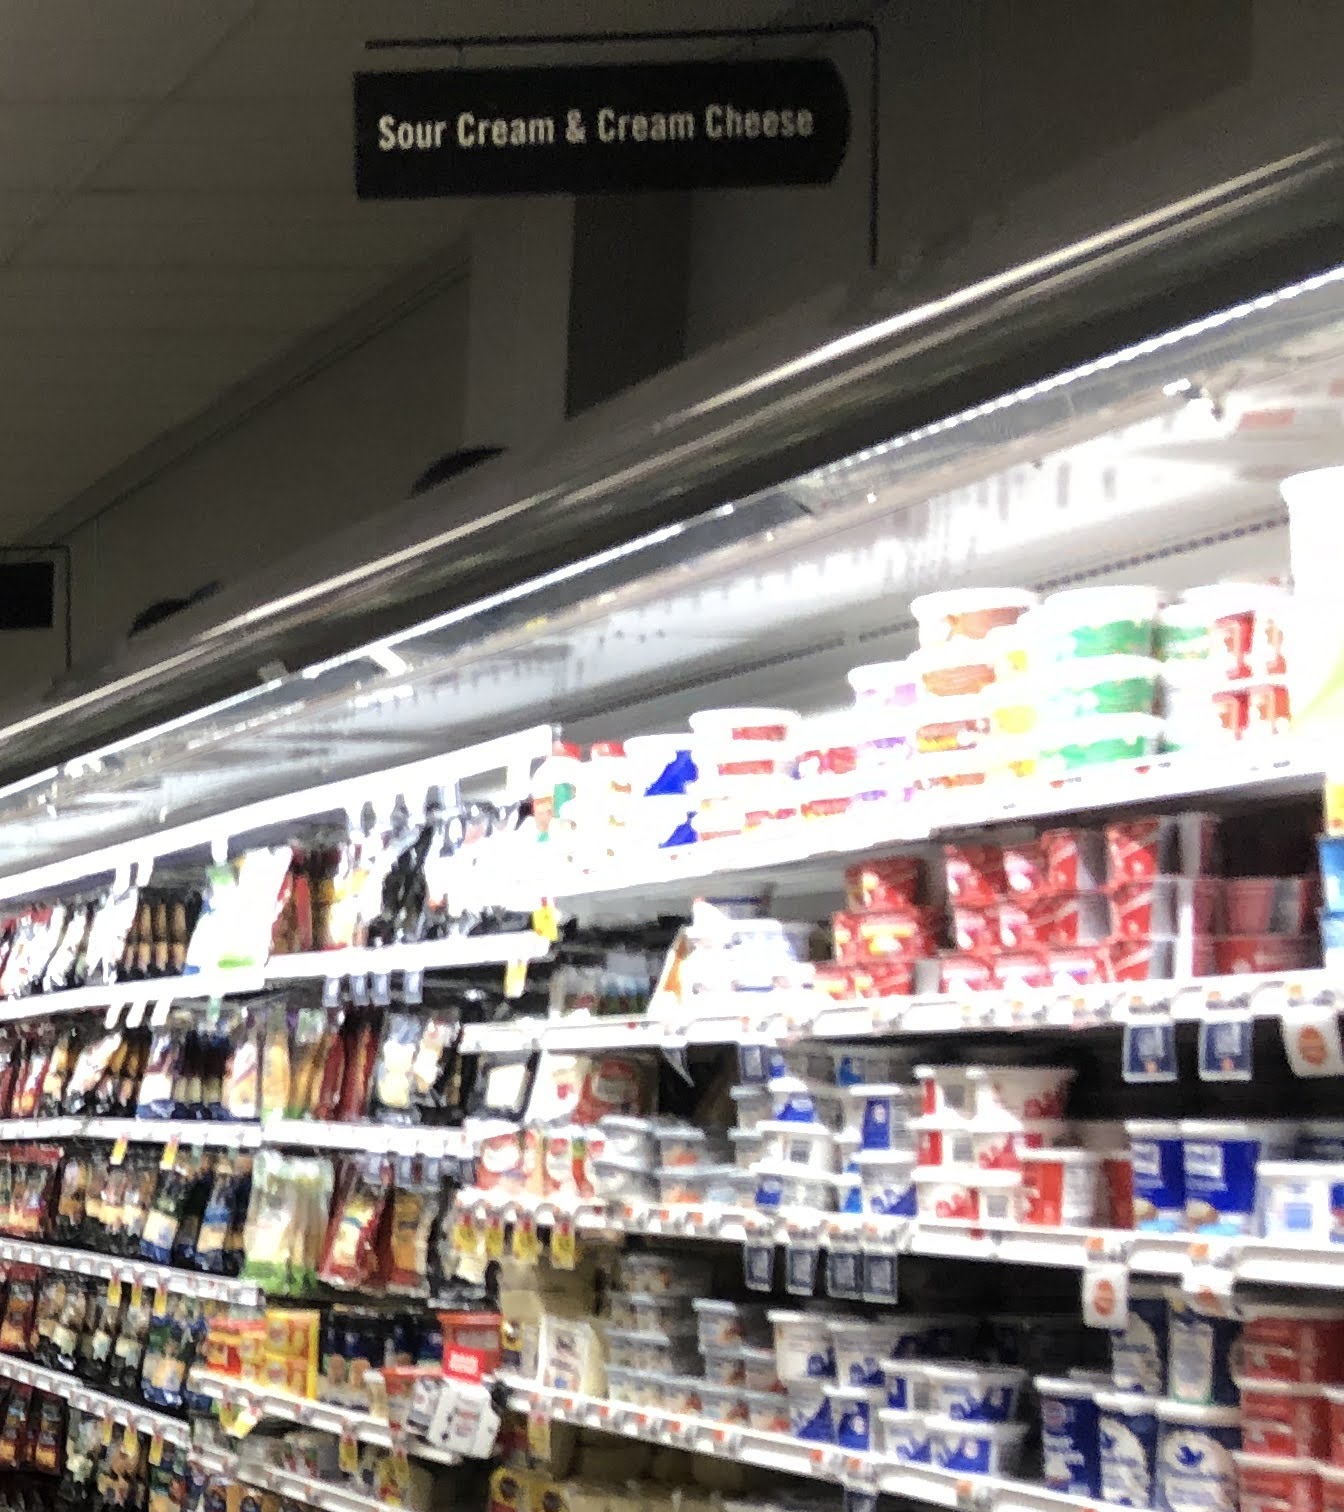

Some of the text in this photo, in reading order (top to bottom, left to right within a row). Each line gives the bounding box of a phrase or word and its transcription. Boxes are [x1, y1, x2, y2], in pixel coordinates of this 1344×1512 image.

[377, 103, 815, 151] Sour Cream & Cream Cheese
